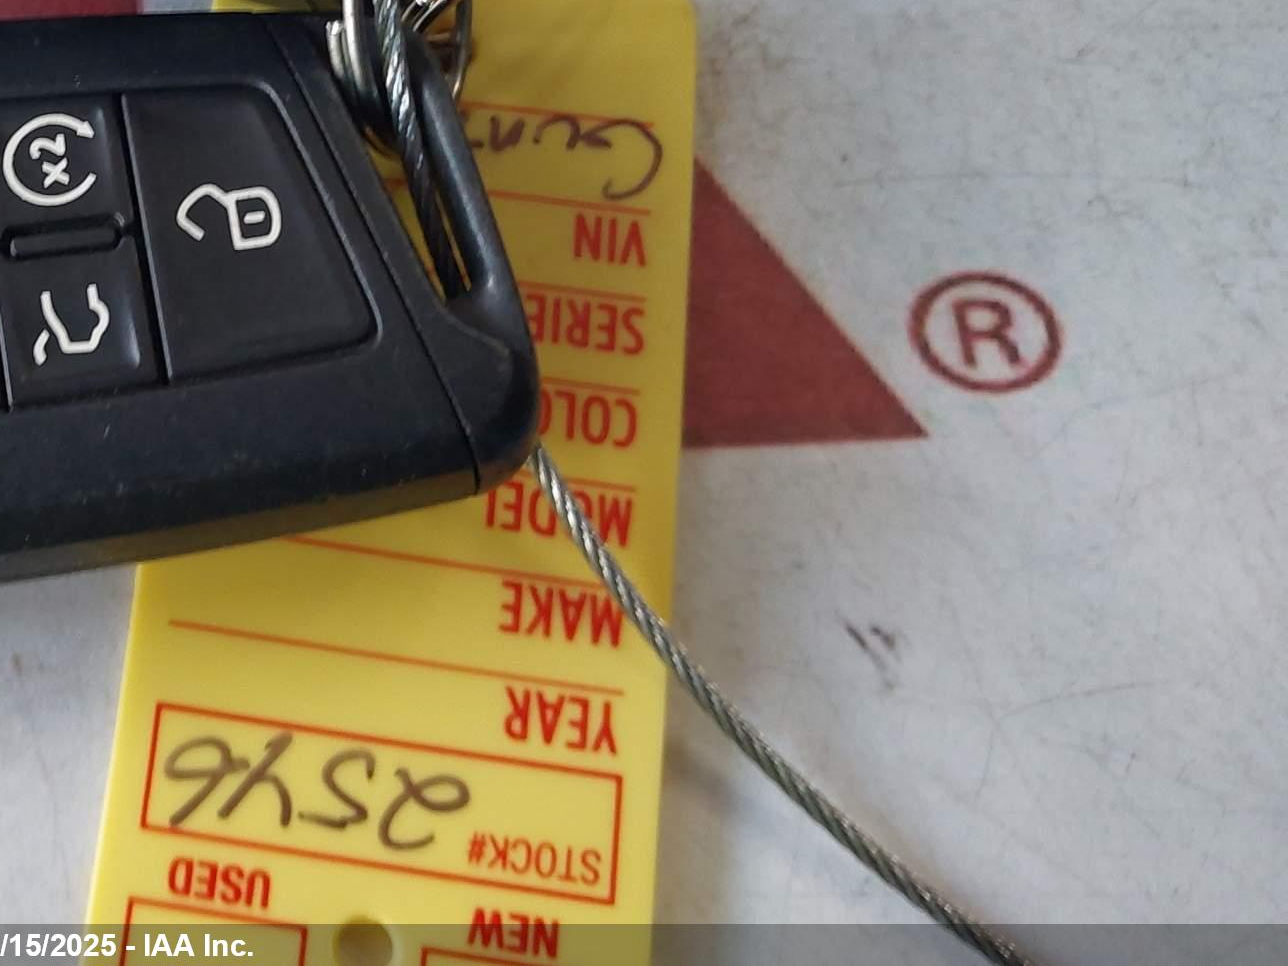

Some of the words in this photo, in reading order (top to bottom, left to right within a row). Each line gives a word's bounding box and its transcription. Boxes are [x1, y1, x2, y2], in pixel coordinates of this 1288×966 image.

[469, 112, 663, 200] Gun
[572, 212, 647, 267] VIN
[525, 292, 646, 356] SERIE
[498, 578, 624, 649] MAKE
[504, 685, 618, 755] YEAR
[167, 856, 271, 909] USED
[468, 830, 602, 885] STOCK#
[468, 907, 560, 959] NEW
